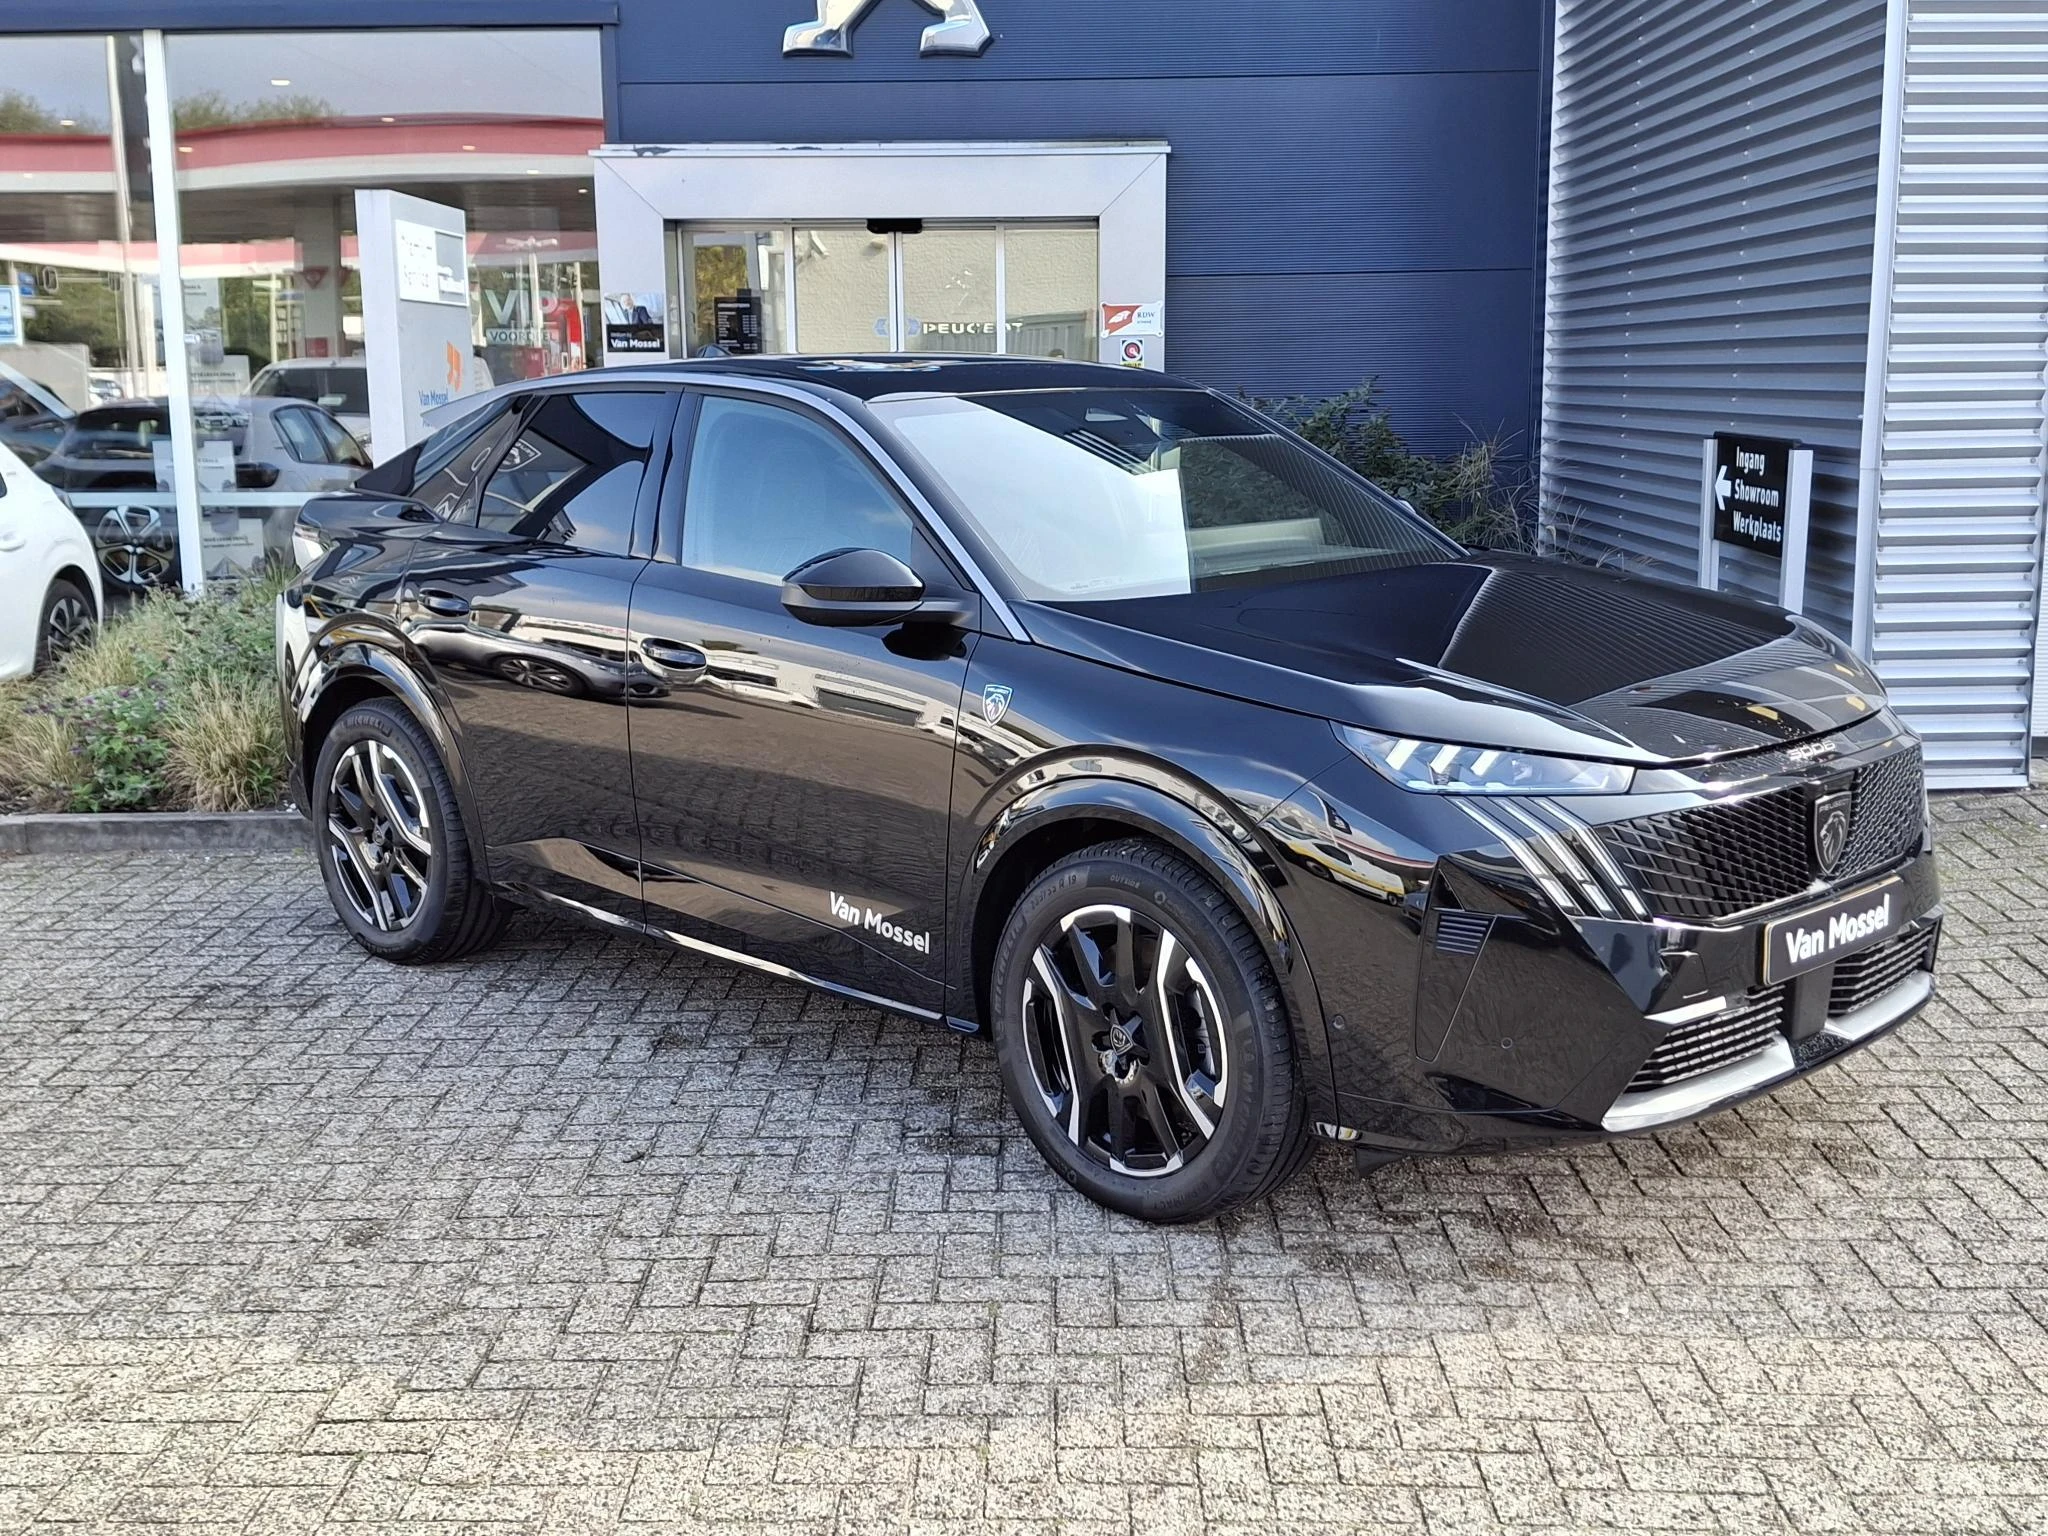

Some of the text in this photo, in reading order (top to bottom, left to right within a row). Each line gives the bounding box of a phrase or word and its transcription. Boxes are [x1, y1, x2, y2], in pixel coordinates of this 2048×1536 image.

[610, 337, 660, 348] Van Mossel
[418, 389, 430, 406] Van
[1735, 445, 1765, 476] Ingang
[1734, 478, 1779, 508] Showroom
[1732, 510, 1782, 542] Werkplaats
[830, 890, 930, 955] Van Mossel
[1785, 892, 1890, 964] Van Mossel
